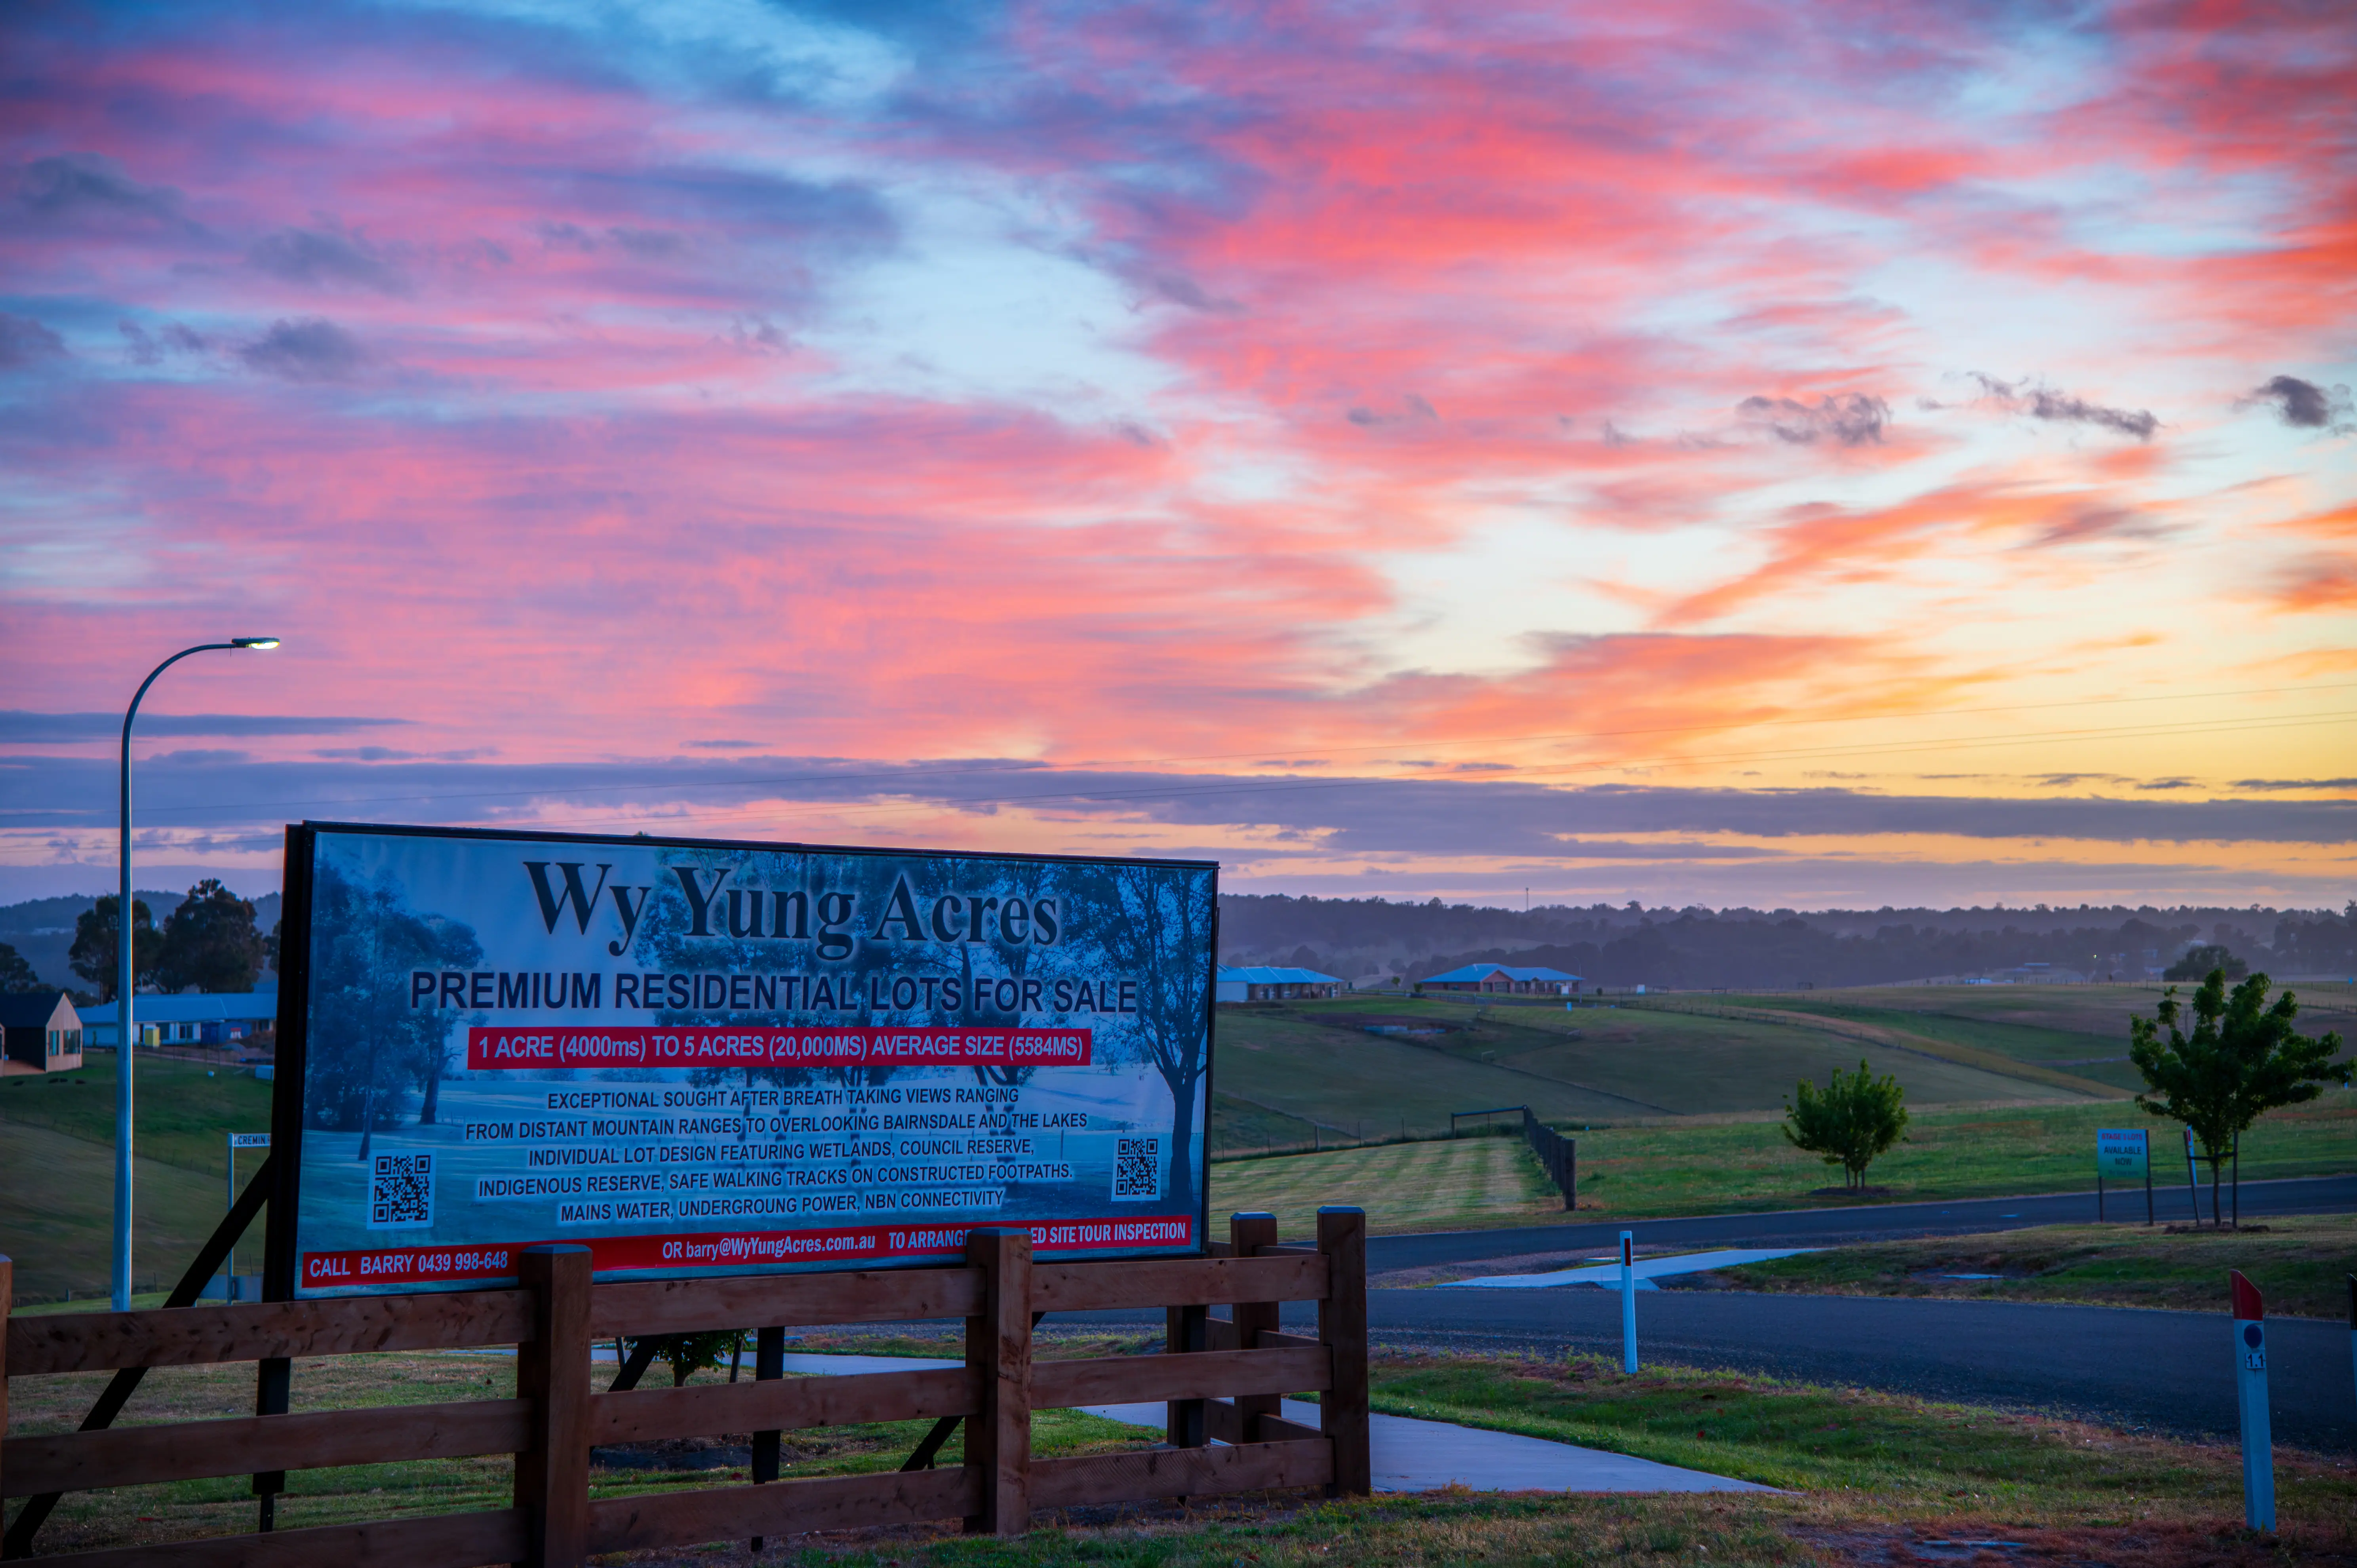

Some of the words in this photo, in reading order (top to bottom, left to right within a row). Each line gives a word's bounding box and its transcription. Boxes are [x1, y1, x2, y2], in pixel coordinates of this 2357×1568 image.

[523, 861, 651, 956] Wy
[672, 867, 855, 960] Yung
[872, 873, 1058, 945] Acres
[411, 972, 601, 1009] PREMIUM
[615, 974, 858, 1010] RESIDENTIAL
[871, 976, 961, 1011] LOTS
[974, 978, 1042, 1012] FOR
[1054, 980, 1137, 1013] SALE
[480, 1039, 488, 1058] 1
[494, 1037, 553, 1058] ACRE
[560, 1036, 646, 1062] (4000ms)
[655, 1036, 679, 1057] TO
[684, 1037, 695, 1056] 5
[699, 1036, 763, 1056] ACRES
[769, 1036, 866, 1061] (20,000MS)
[871, 1035, 960, 1056] AVERAGE
[965, 1037, 1004, 1056] SIZE
[1009, 1036, 1082, 1060] (5584MS)
[548, 1093, 659, 1109] EXCEPTIONAL
[664, 1091, 726, 1107] SOUGHT
[729, 1090, 779, 1106] AFTER
[784, 1090, 842, 1106] BREATH
[848, 1089, 901, 1104] TAKING
[906, 1088, 951, 1103] VIEWS
[956, 1088, 1019, 1103] RANGING
[238, 1136, 265, 1145] CREMIN
[466, 1123, 513, 1140] FROM
[519, 1121, 586, 1138] DISTANT
[592, 1119, 673, 1137] MOUNTAIN
[679, 1118, 741, 1134] RANGES
[746, 1117, 765, 1133] TO
[770, 1115, 879, 1132] OVERLOOKING
[884, 1113, 975, 1130] BAIRNSDALE
[979, 1113, 1007, 1128] AND
[1012, 1113, 1038, 1127] THE
[1043, 1113, 1087, 1127] LAKES
[529, 1149, 619, 1166] INDIVIDUAL
[624, 1147, 655, 1163] LOT
[660, 1146, 716, 1162] DESIGN
[721, 1144, 803, 1160] FEATURING
[809, 1142, 895, 1159] WETLANDS,
[900, 1140, 963, 1156] COUNCIL
[968, 1139, 1034, 1156] RESERVE,
[479, 1179, 582, 1196] INDIGENOUS
[587, 1176, 664, 1195] RESERVE,
[669, 1174, 710, 1190] SAFE
[714, 1172, 781, 1188] WALKING
[786, 1169, 847, 1186] TRACKS
[851, 1168, 872, 1184] ON
[877, 1166, 984, 1183] CONSTRUCTED
[988, 1164, 1072, 1180] FOOTPATHS.
[561, 1204, 611, 1222] MAINS
[616, 1203, 674, 1222] WATER,
[679, 1197, 797, 1217] UNDERGROUNG
[802, 1196, 860, 1213] POWER,
[865, 1194, 896, 1209] NBN
[901, 1191, 1004, 1208] CONNECTIVITY
[310, 1258, 351, 1278] CALL
[360, 1254, 414, 1275] BARRY
[418, 1254, 451, 1272] 0439
[455, 1251, 508, 1271] 998-648
[663, 1241, 682, 1259] OR
[686, 1234, 875, 1260] barry@WyYungAcres.com.au
[889, 1232, 905, 1249] TO
[1049, 1226, 1076, 1244] SITE
[1078, 1224, 1111, 1243] TOUR
[1114, 1222, 1186, 1241] INSPECTION
